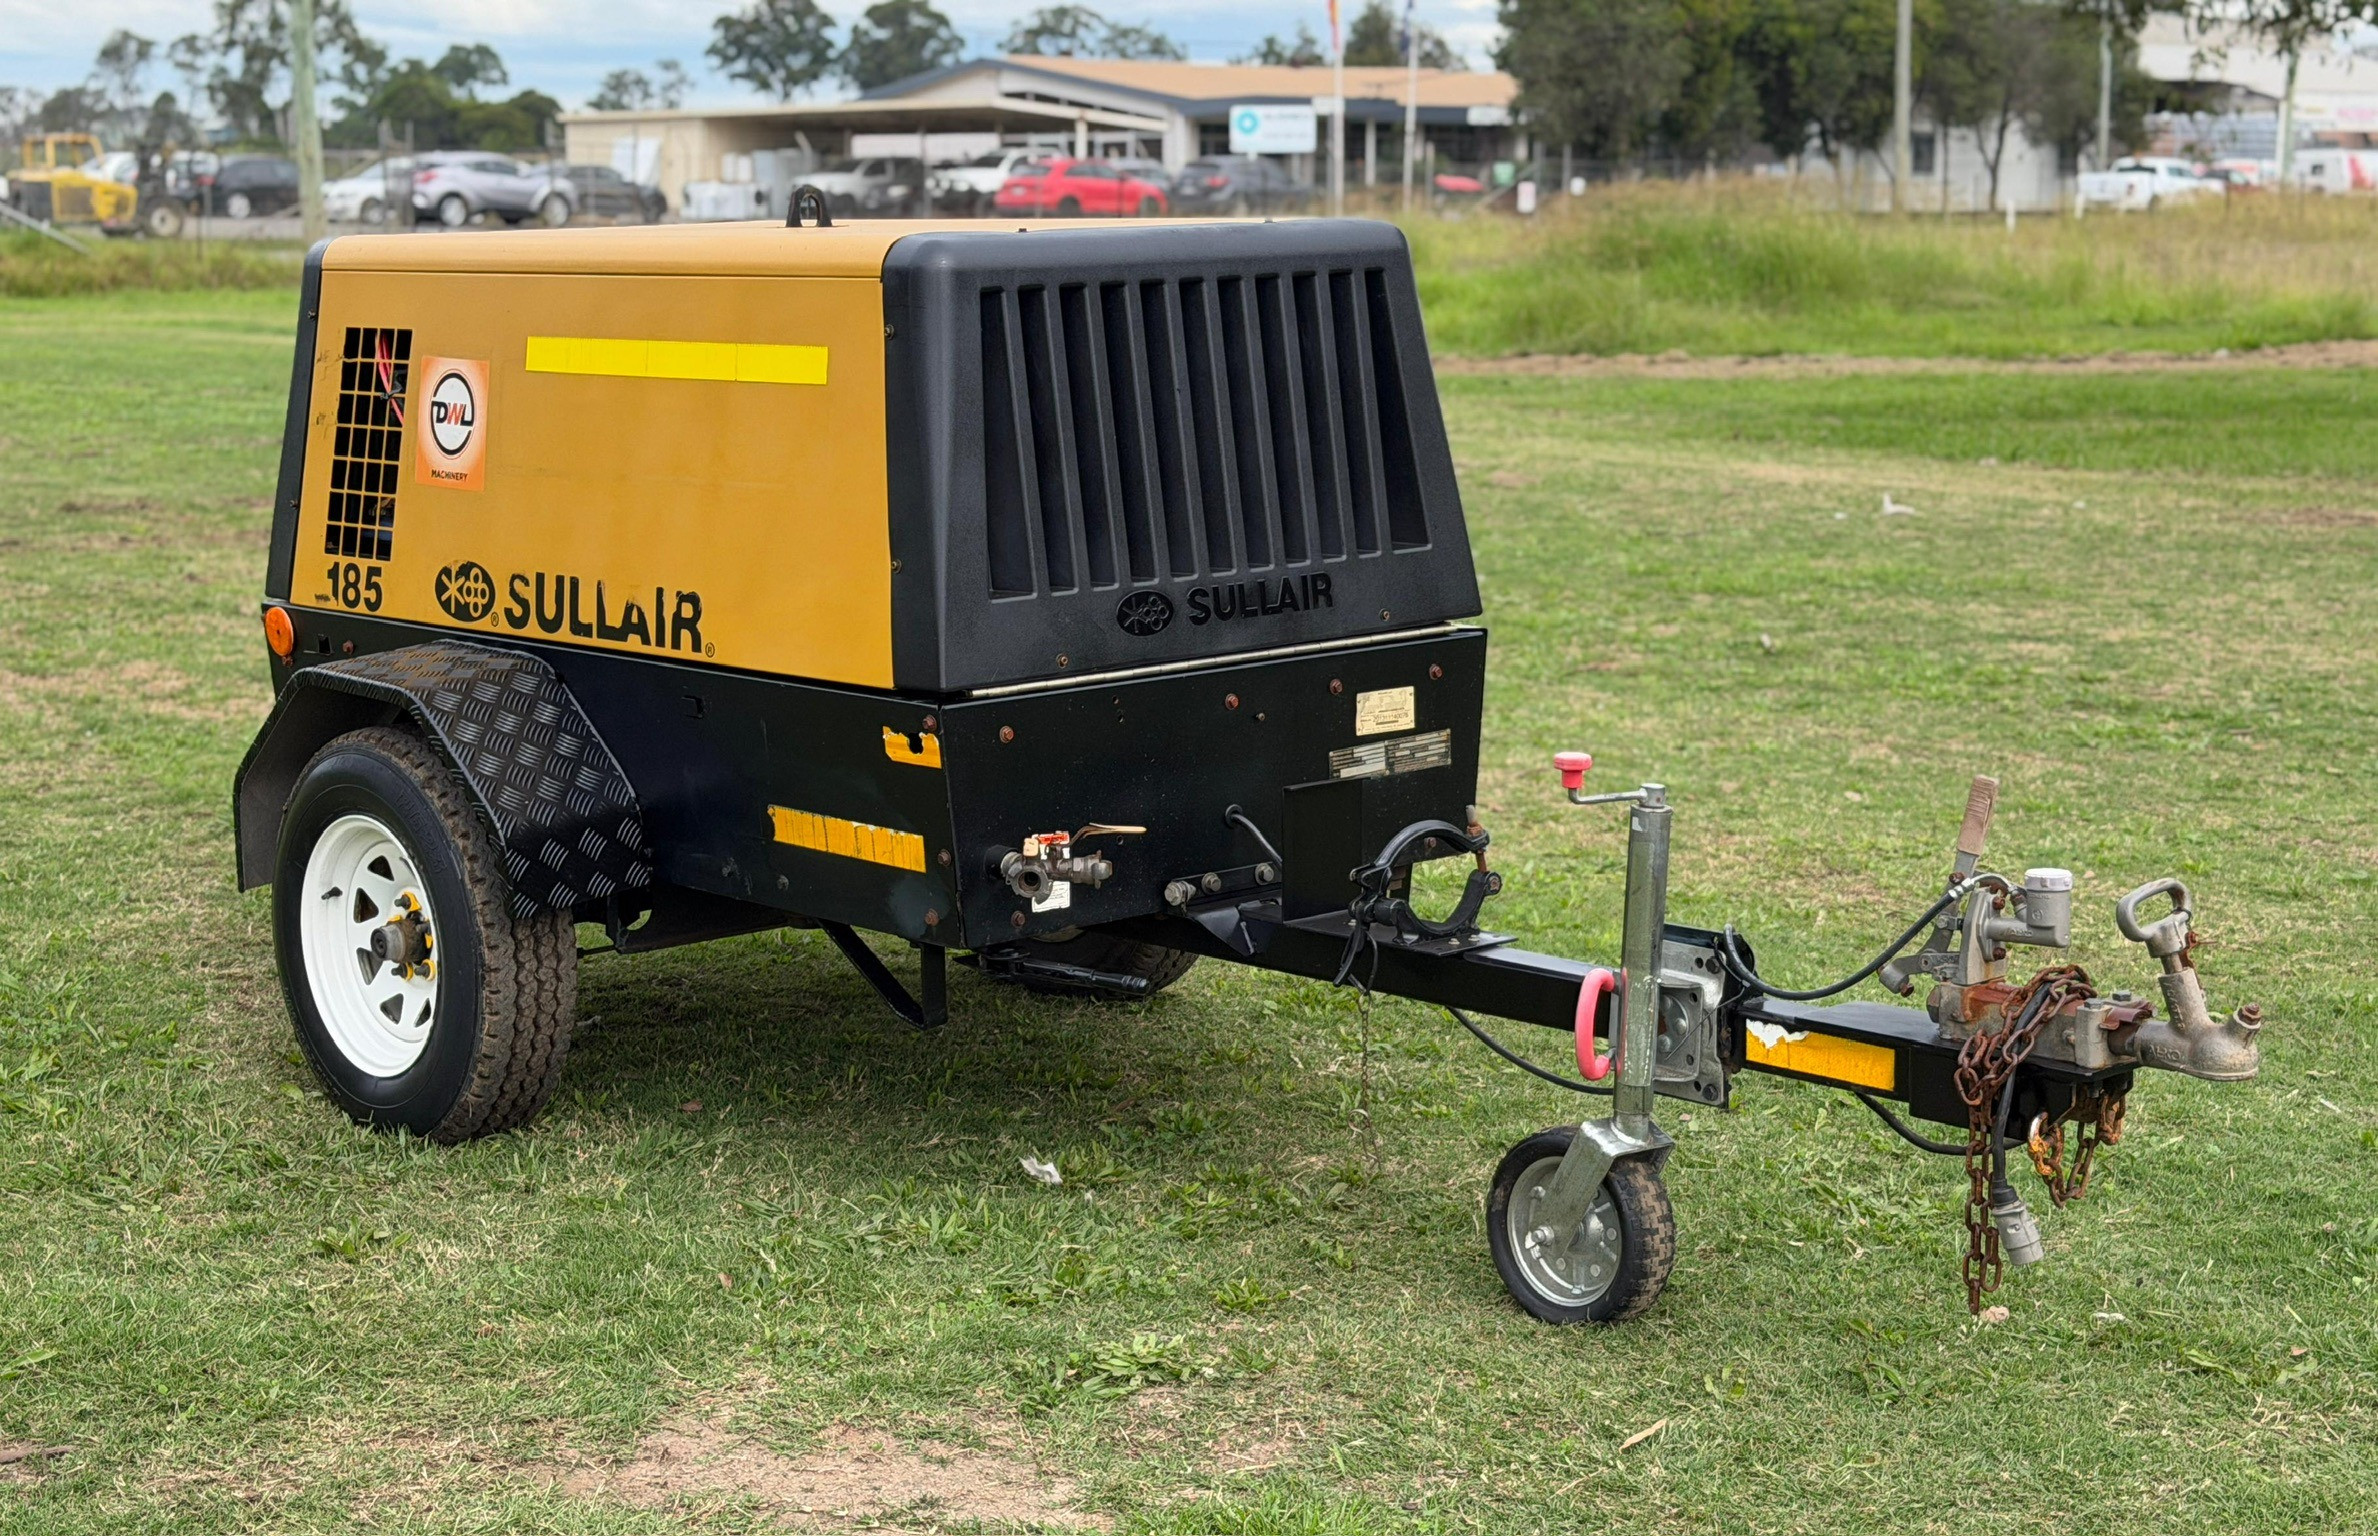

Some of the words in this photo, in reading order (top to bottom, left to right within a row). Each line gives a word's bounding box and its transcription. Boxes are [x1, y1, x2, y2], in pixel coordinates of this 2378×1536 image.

[432, 400, 473, 427] DWL
[431, 469, 468, 482] MACHINERY
[327, 561, 382, 612] 185
[1187, 572, 1333, 626] SULLAIR
[504, 572, 702, 653] SULLAIR
